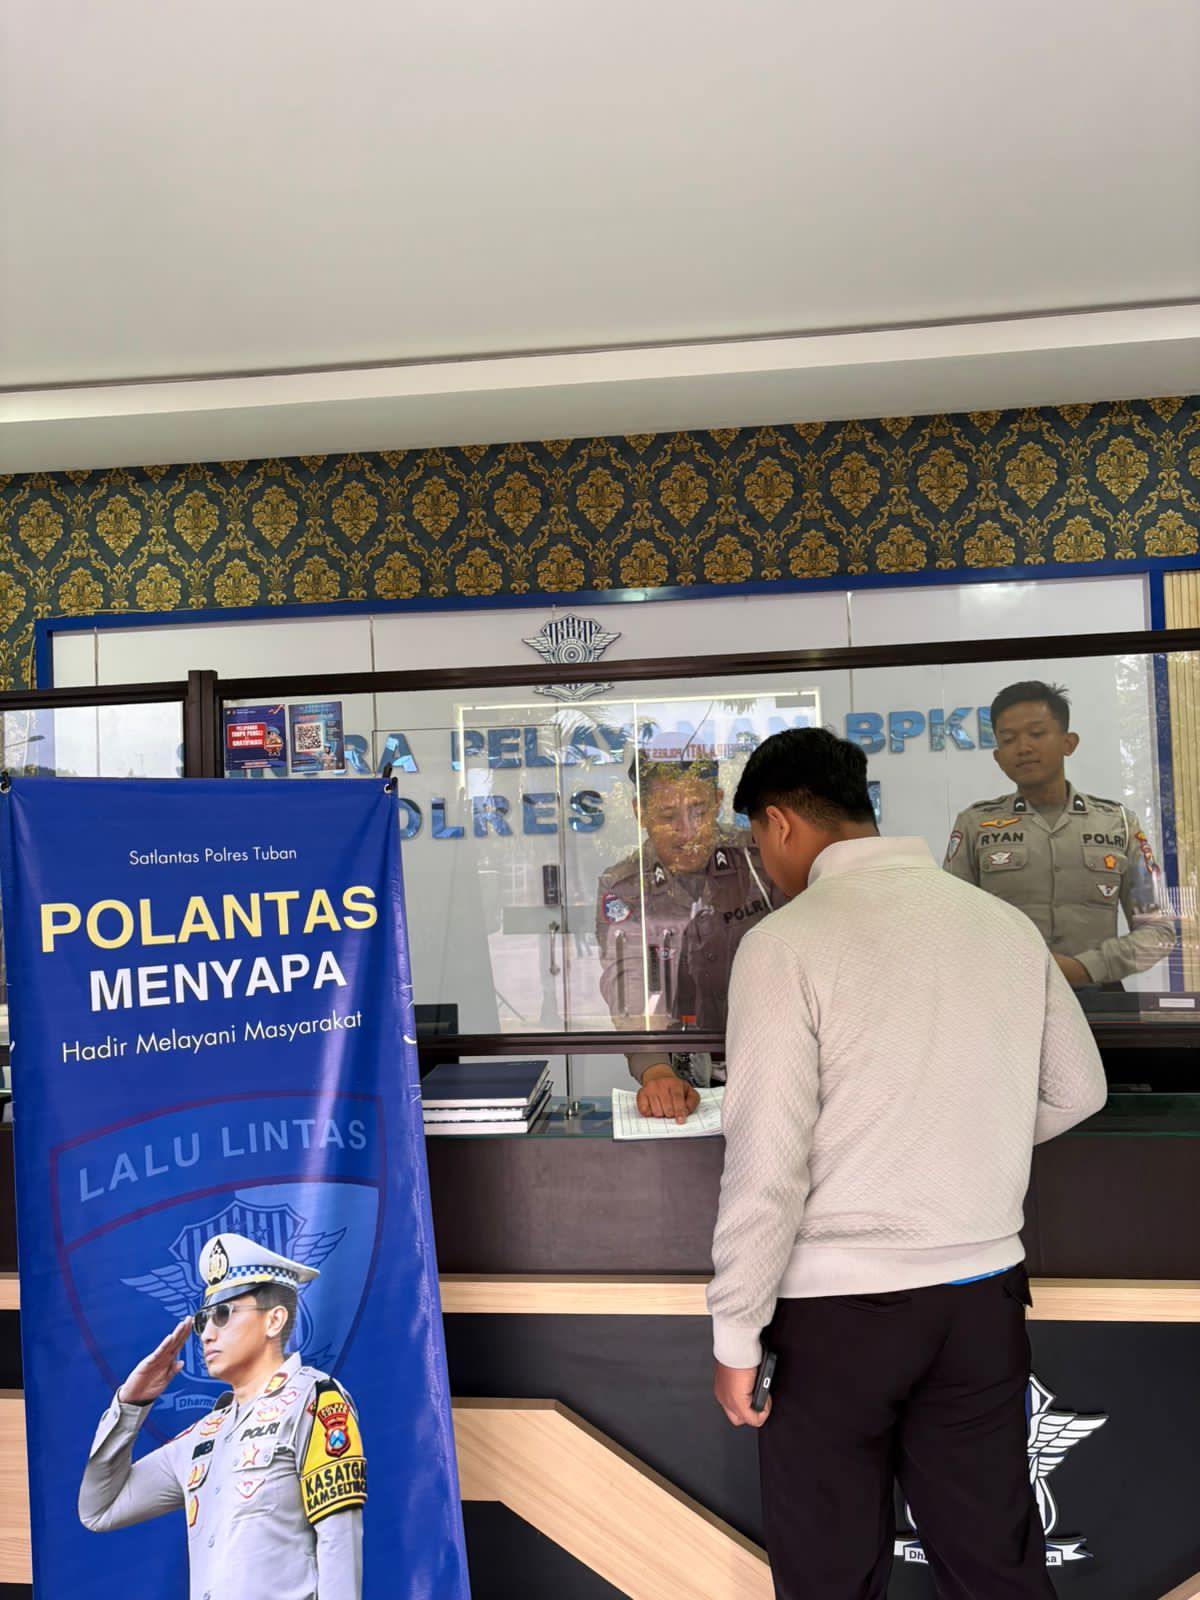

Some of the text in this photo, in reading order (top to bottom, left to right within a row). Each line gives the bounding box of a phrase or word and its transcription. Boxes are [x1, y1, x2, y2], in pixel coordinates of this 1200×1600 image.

[398, 789, 606, 841] OLRES
[980, 832, 1024, 846] RYAN
[129, 845, 297, 866] Satlantas Polres Tuban
[40, 885, 379, 953] POLANTAS
[90, 951, 347, 1012] MENYAPA
[62, 1010, 363, 1063] Hadir Melayani Masyarakat
[79, 1118, 367, 1202] LALU LINTAS
[240, 1422, 281, 1441] POLRI
